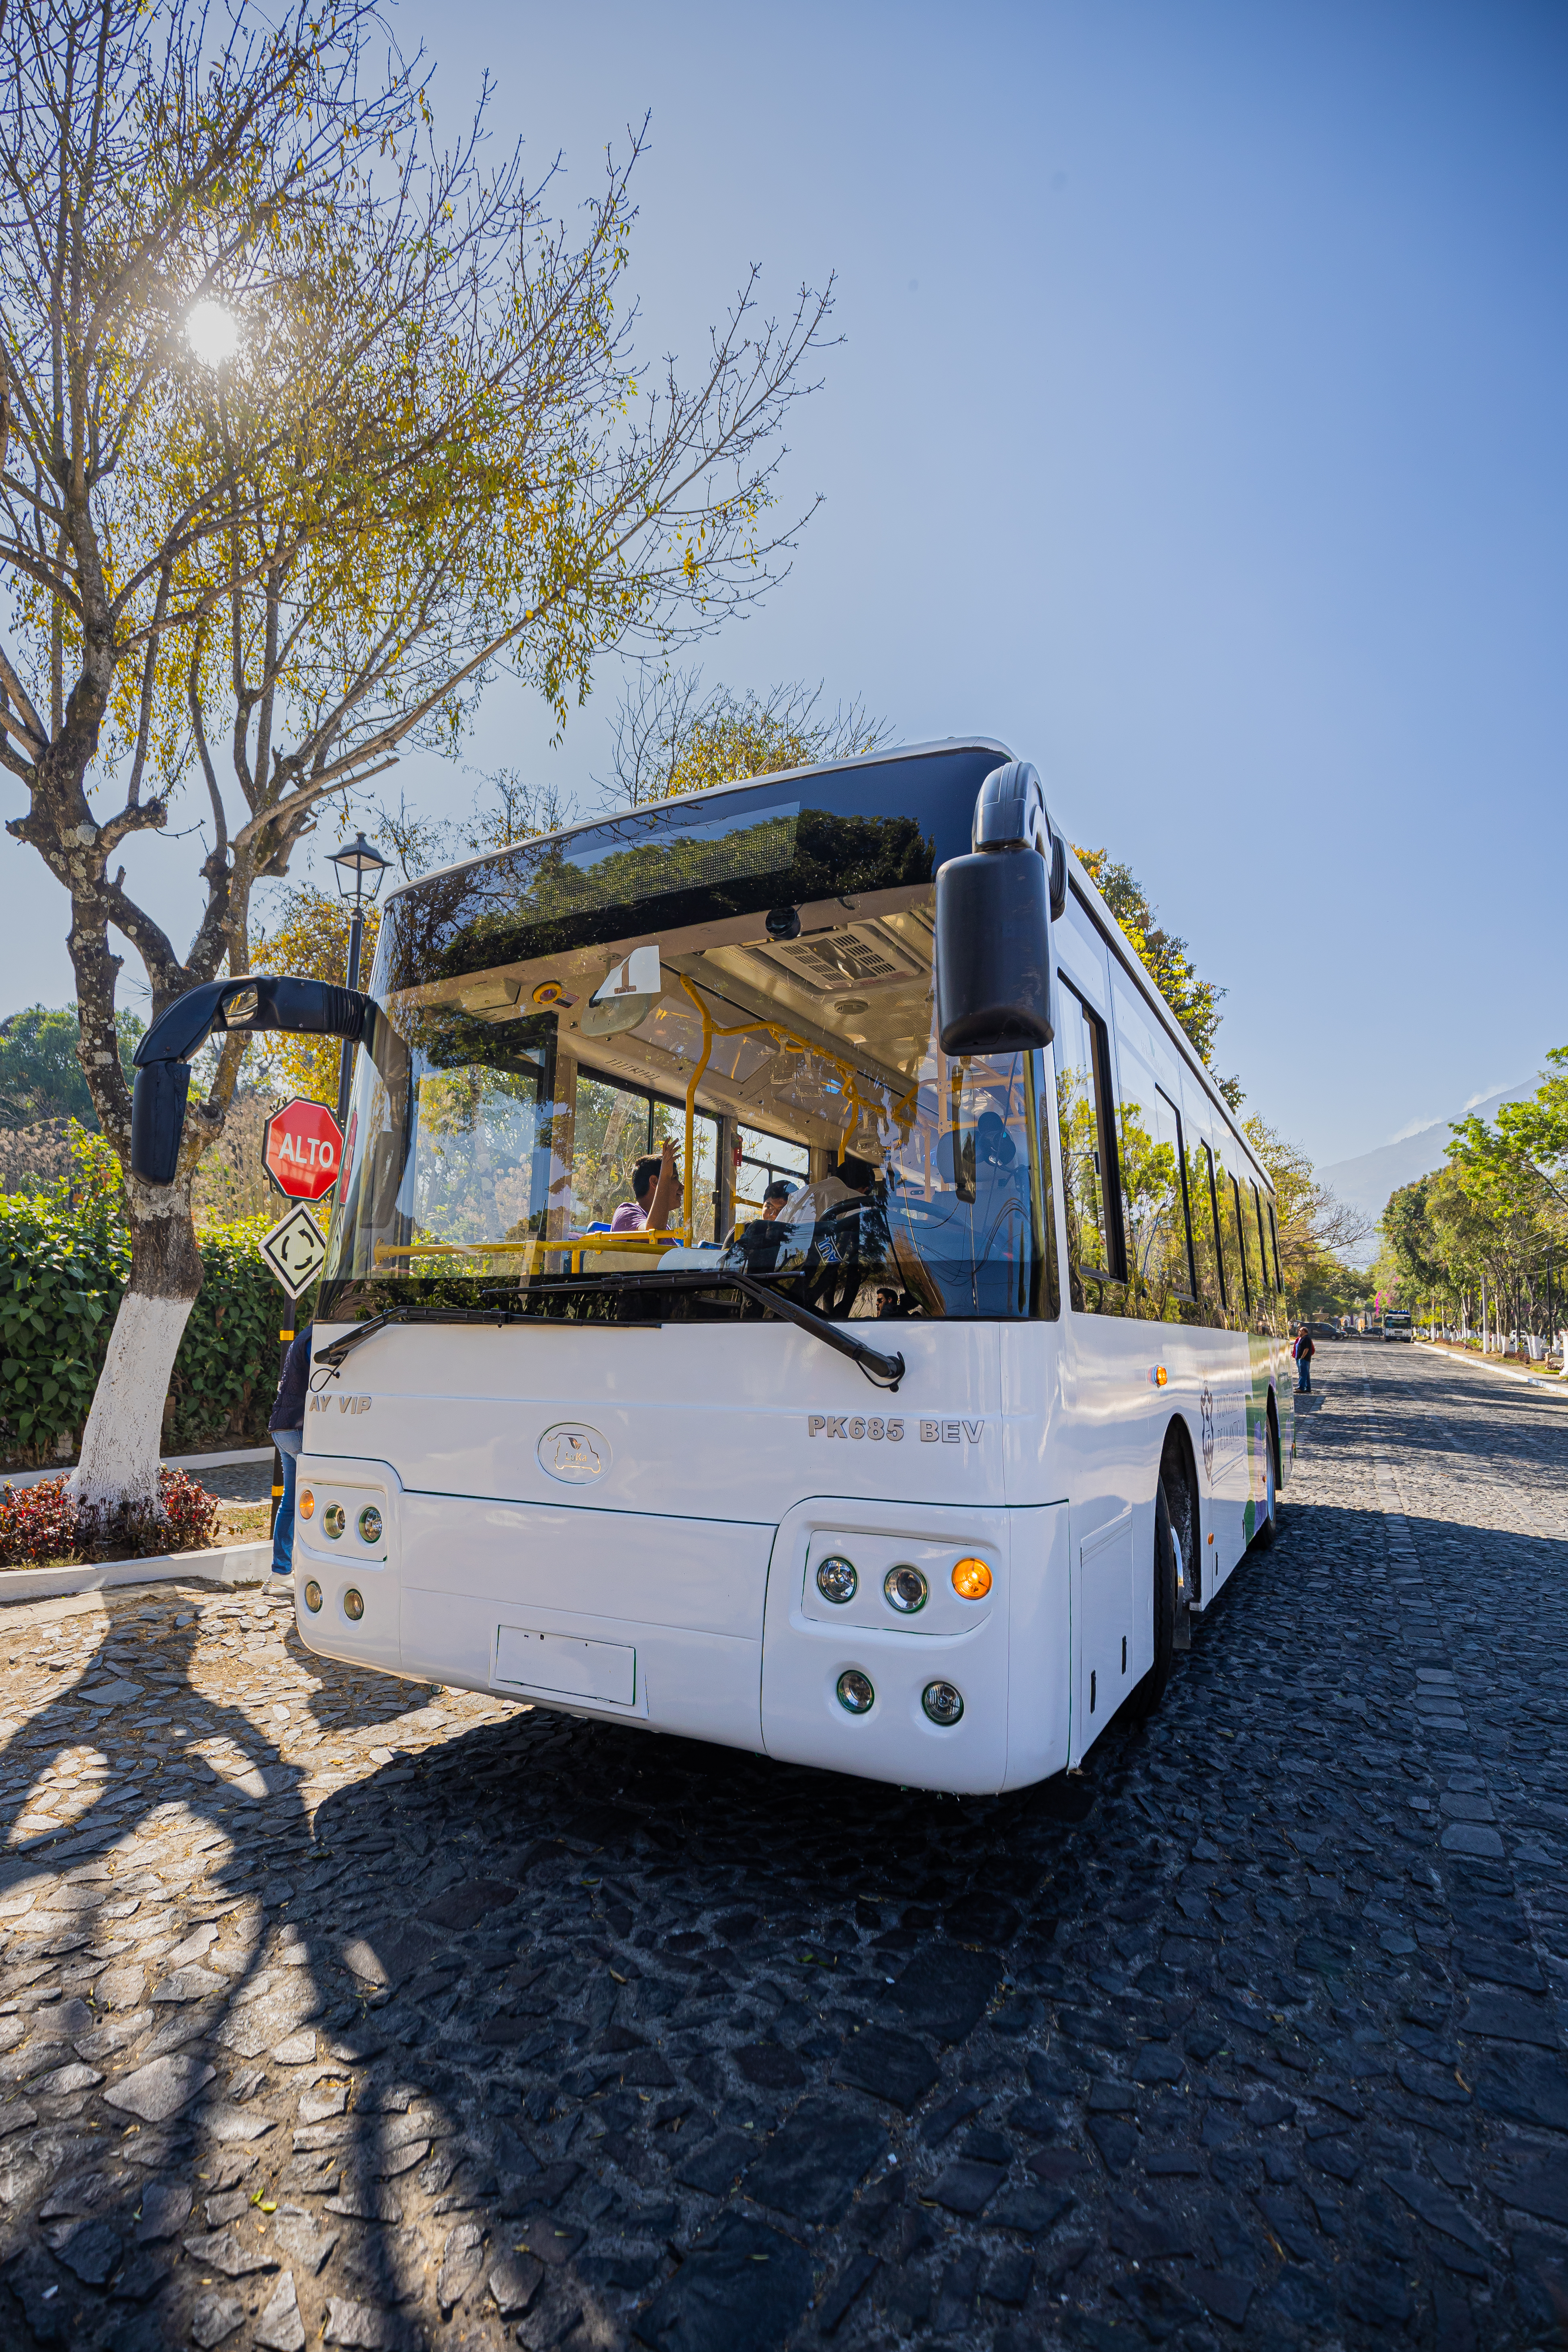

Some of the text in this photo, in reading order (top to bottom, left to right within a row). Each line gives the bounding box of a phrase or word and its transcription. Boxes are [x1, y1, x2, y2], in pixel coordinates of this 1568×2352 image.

[278, 1133, 334, 1168] ALTO
[338, 1396, 372, 1414] VIP
[808, 1415, 985, 1444] PK685 BEV
[566, 1451, 587, 1462] LuKa
